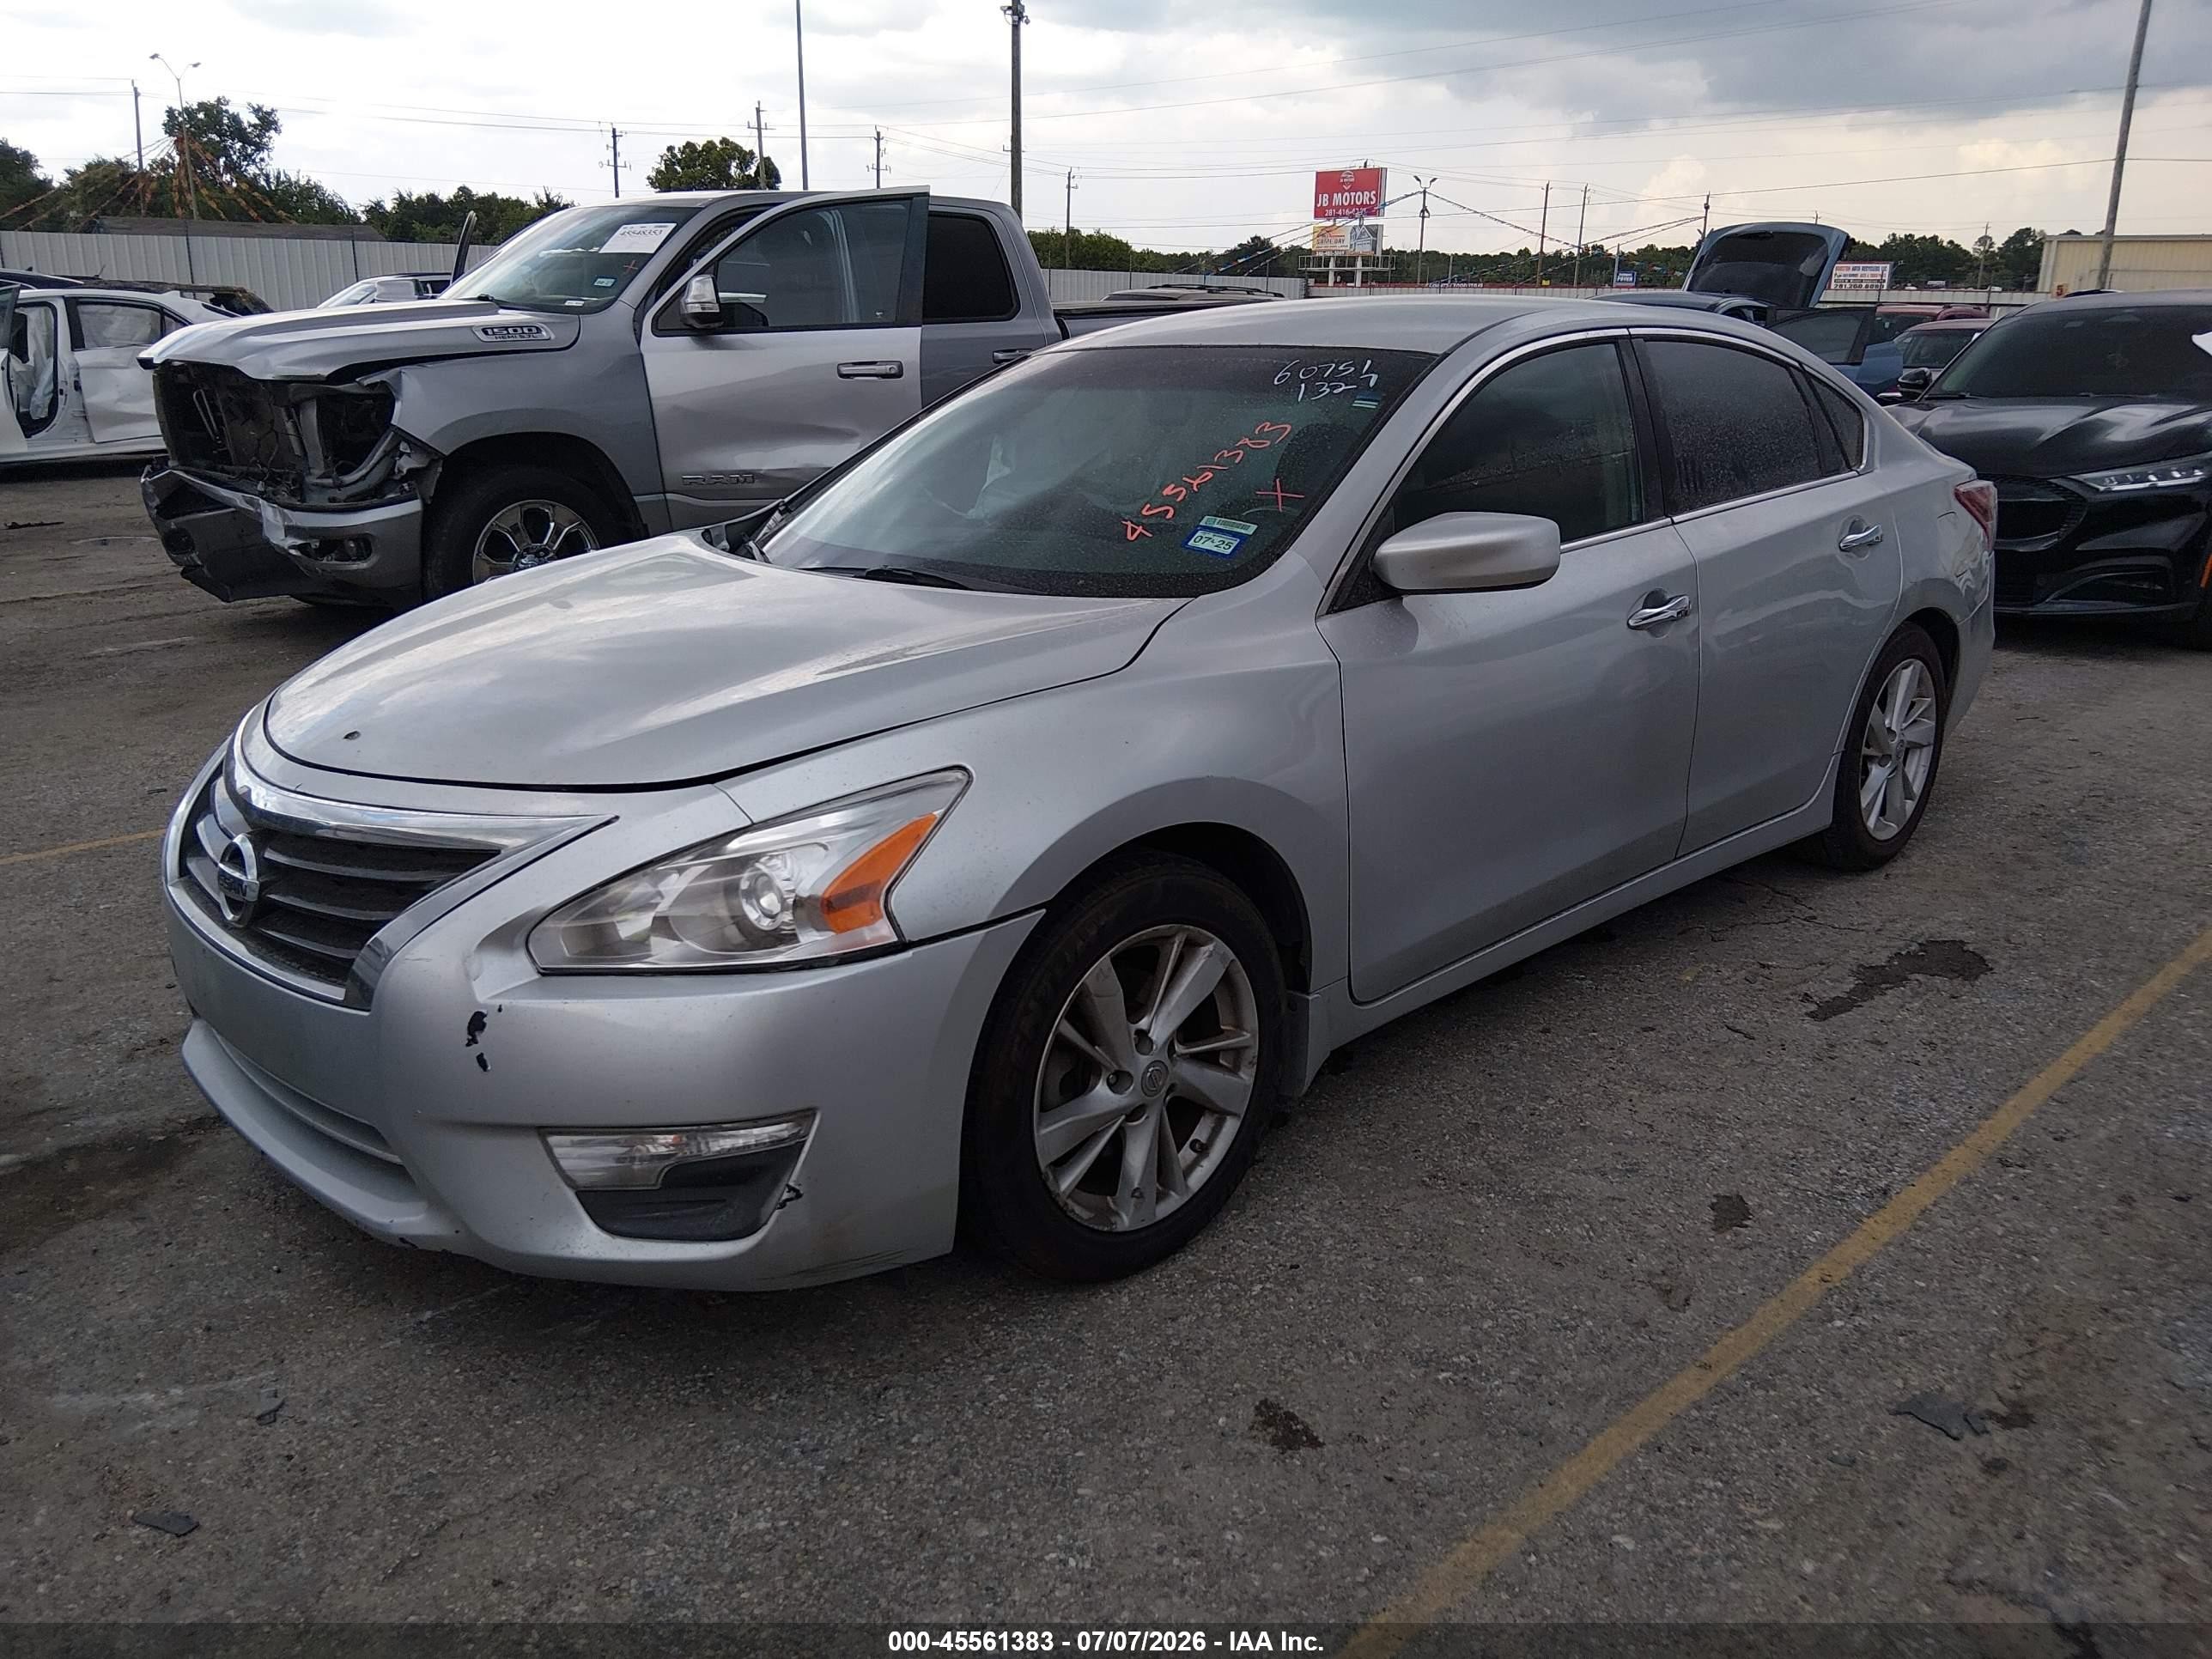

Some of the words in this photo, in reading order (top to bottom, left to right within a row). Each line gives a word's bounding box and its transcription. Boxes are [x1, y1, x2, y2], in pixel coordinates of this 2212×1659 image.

[1317, 193, 1329, 207] JB
[1332, 191, 1376, 206] MOTORS
[485, 326, 538, 335] 1500
[681, 474, 756, 486] RAM
